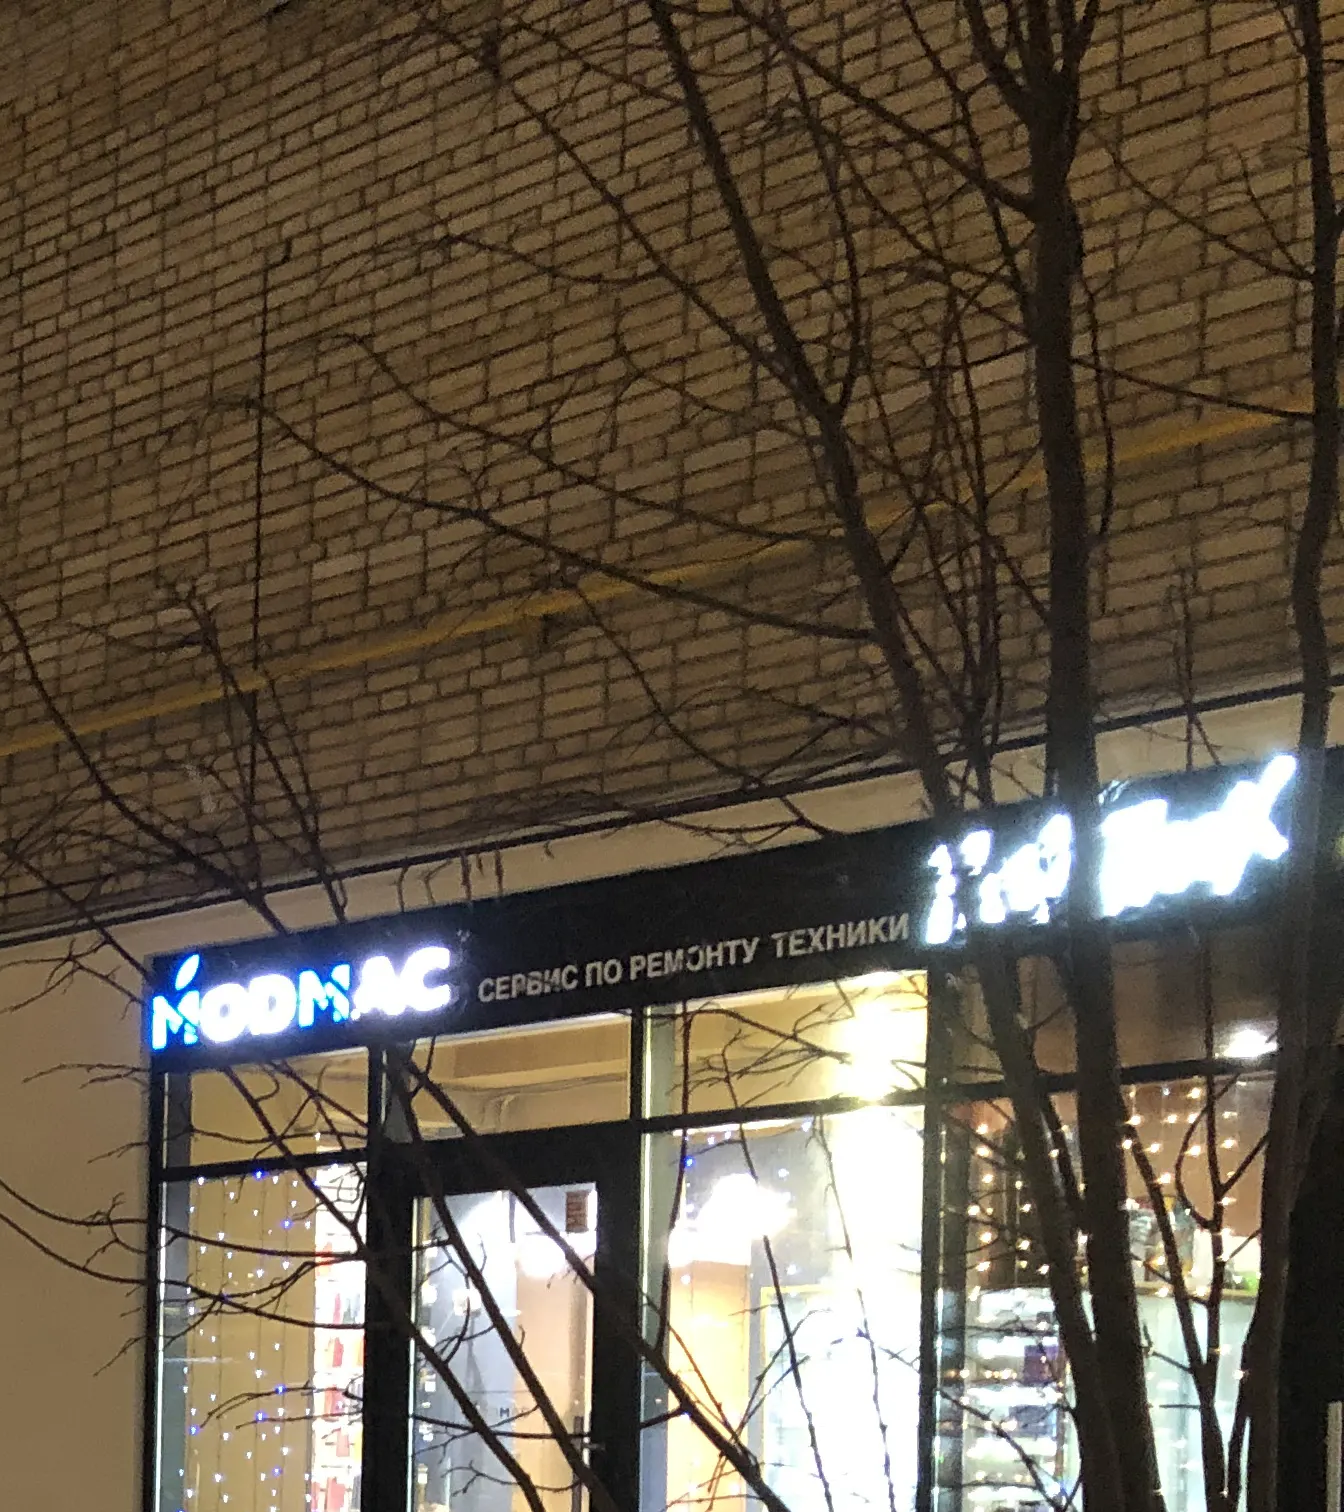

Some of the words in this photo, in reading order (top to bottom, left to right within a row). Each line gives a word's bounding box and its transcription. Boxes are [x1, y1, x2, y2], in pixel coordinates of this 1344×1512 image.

[478, 964, 579, 1003] СЕРВИС
[584, 957, 624, 987] ПО
[629, 937, 759, 981] РЕМОНТУ
[770, 912, 910, 958] ТЕХНИКИ
